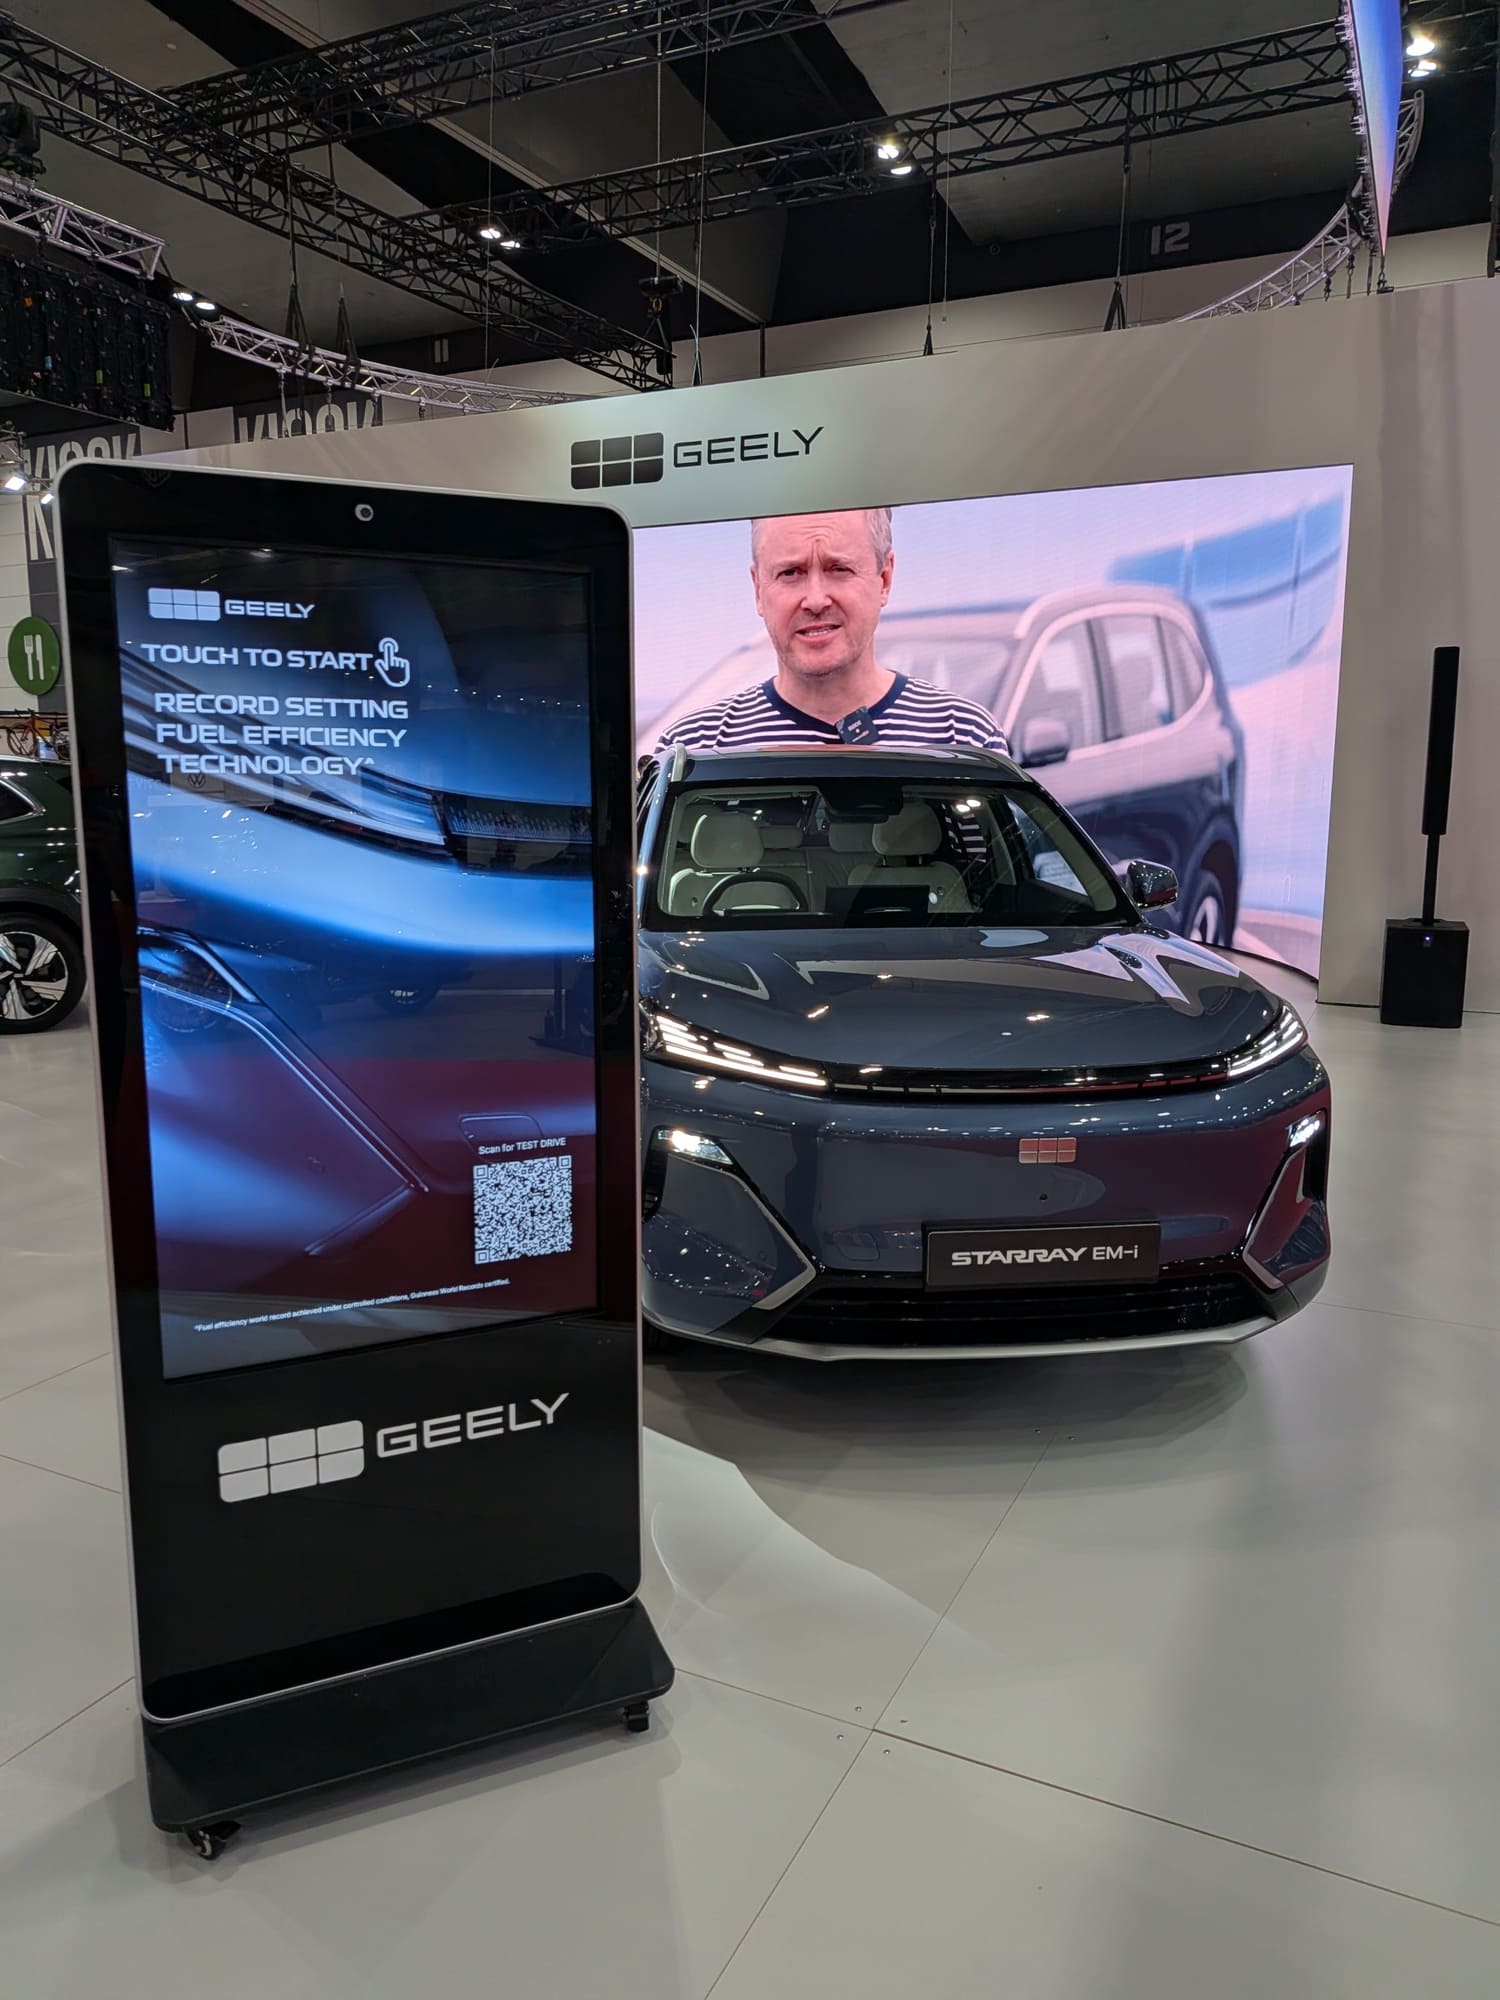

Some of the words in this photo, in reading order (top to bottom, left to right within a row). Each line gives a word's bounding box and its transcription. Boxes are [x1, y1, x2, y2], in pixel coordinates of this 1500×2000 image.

[1151, 221, 1191, 255] 12
[673, 426, 825, 468] GEELY
[224, 599, 315, 619] GEELY
[140, 643, 239, 666] TOUCH
[243, 647, 283, 667] TO
[287, 650, 374, 671] START
[154, 692, 280, 716] RECORD
[285, 697, 409, 720] SETTING
[155, 723, 237, 744] FUEL
[242, 725, 408, 748] EFFICIENCY
[478, 1145, 501, 1155] Scan
[501, 1143, 515, 1152] for
[515, 1140, 539, 1151] TEST
[540, 1137, 567, 1149] DRIVE
[951, 1247, 1087, 1266] STARRAY
[1092, 1245, 1139, 1261] EM-i
[214, 1319, 248, 1329] efficiency
[249, 1315, 268, 1323] world
[269, 1311, 292, 1320] record
[292, 1306, 322, 1317] achieved
[322, 1304, 341, 1312] under
[440, 1286, 459, 1295] World
[459, 1282, 484, 1292] Records
[376, 1392, 569, 1458] GEELY
